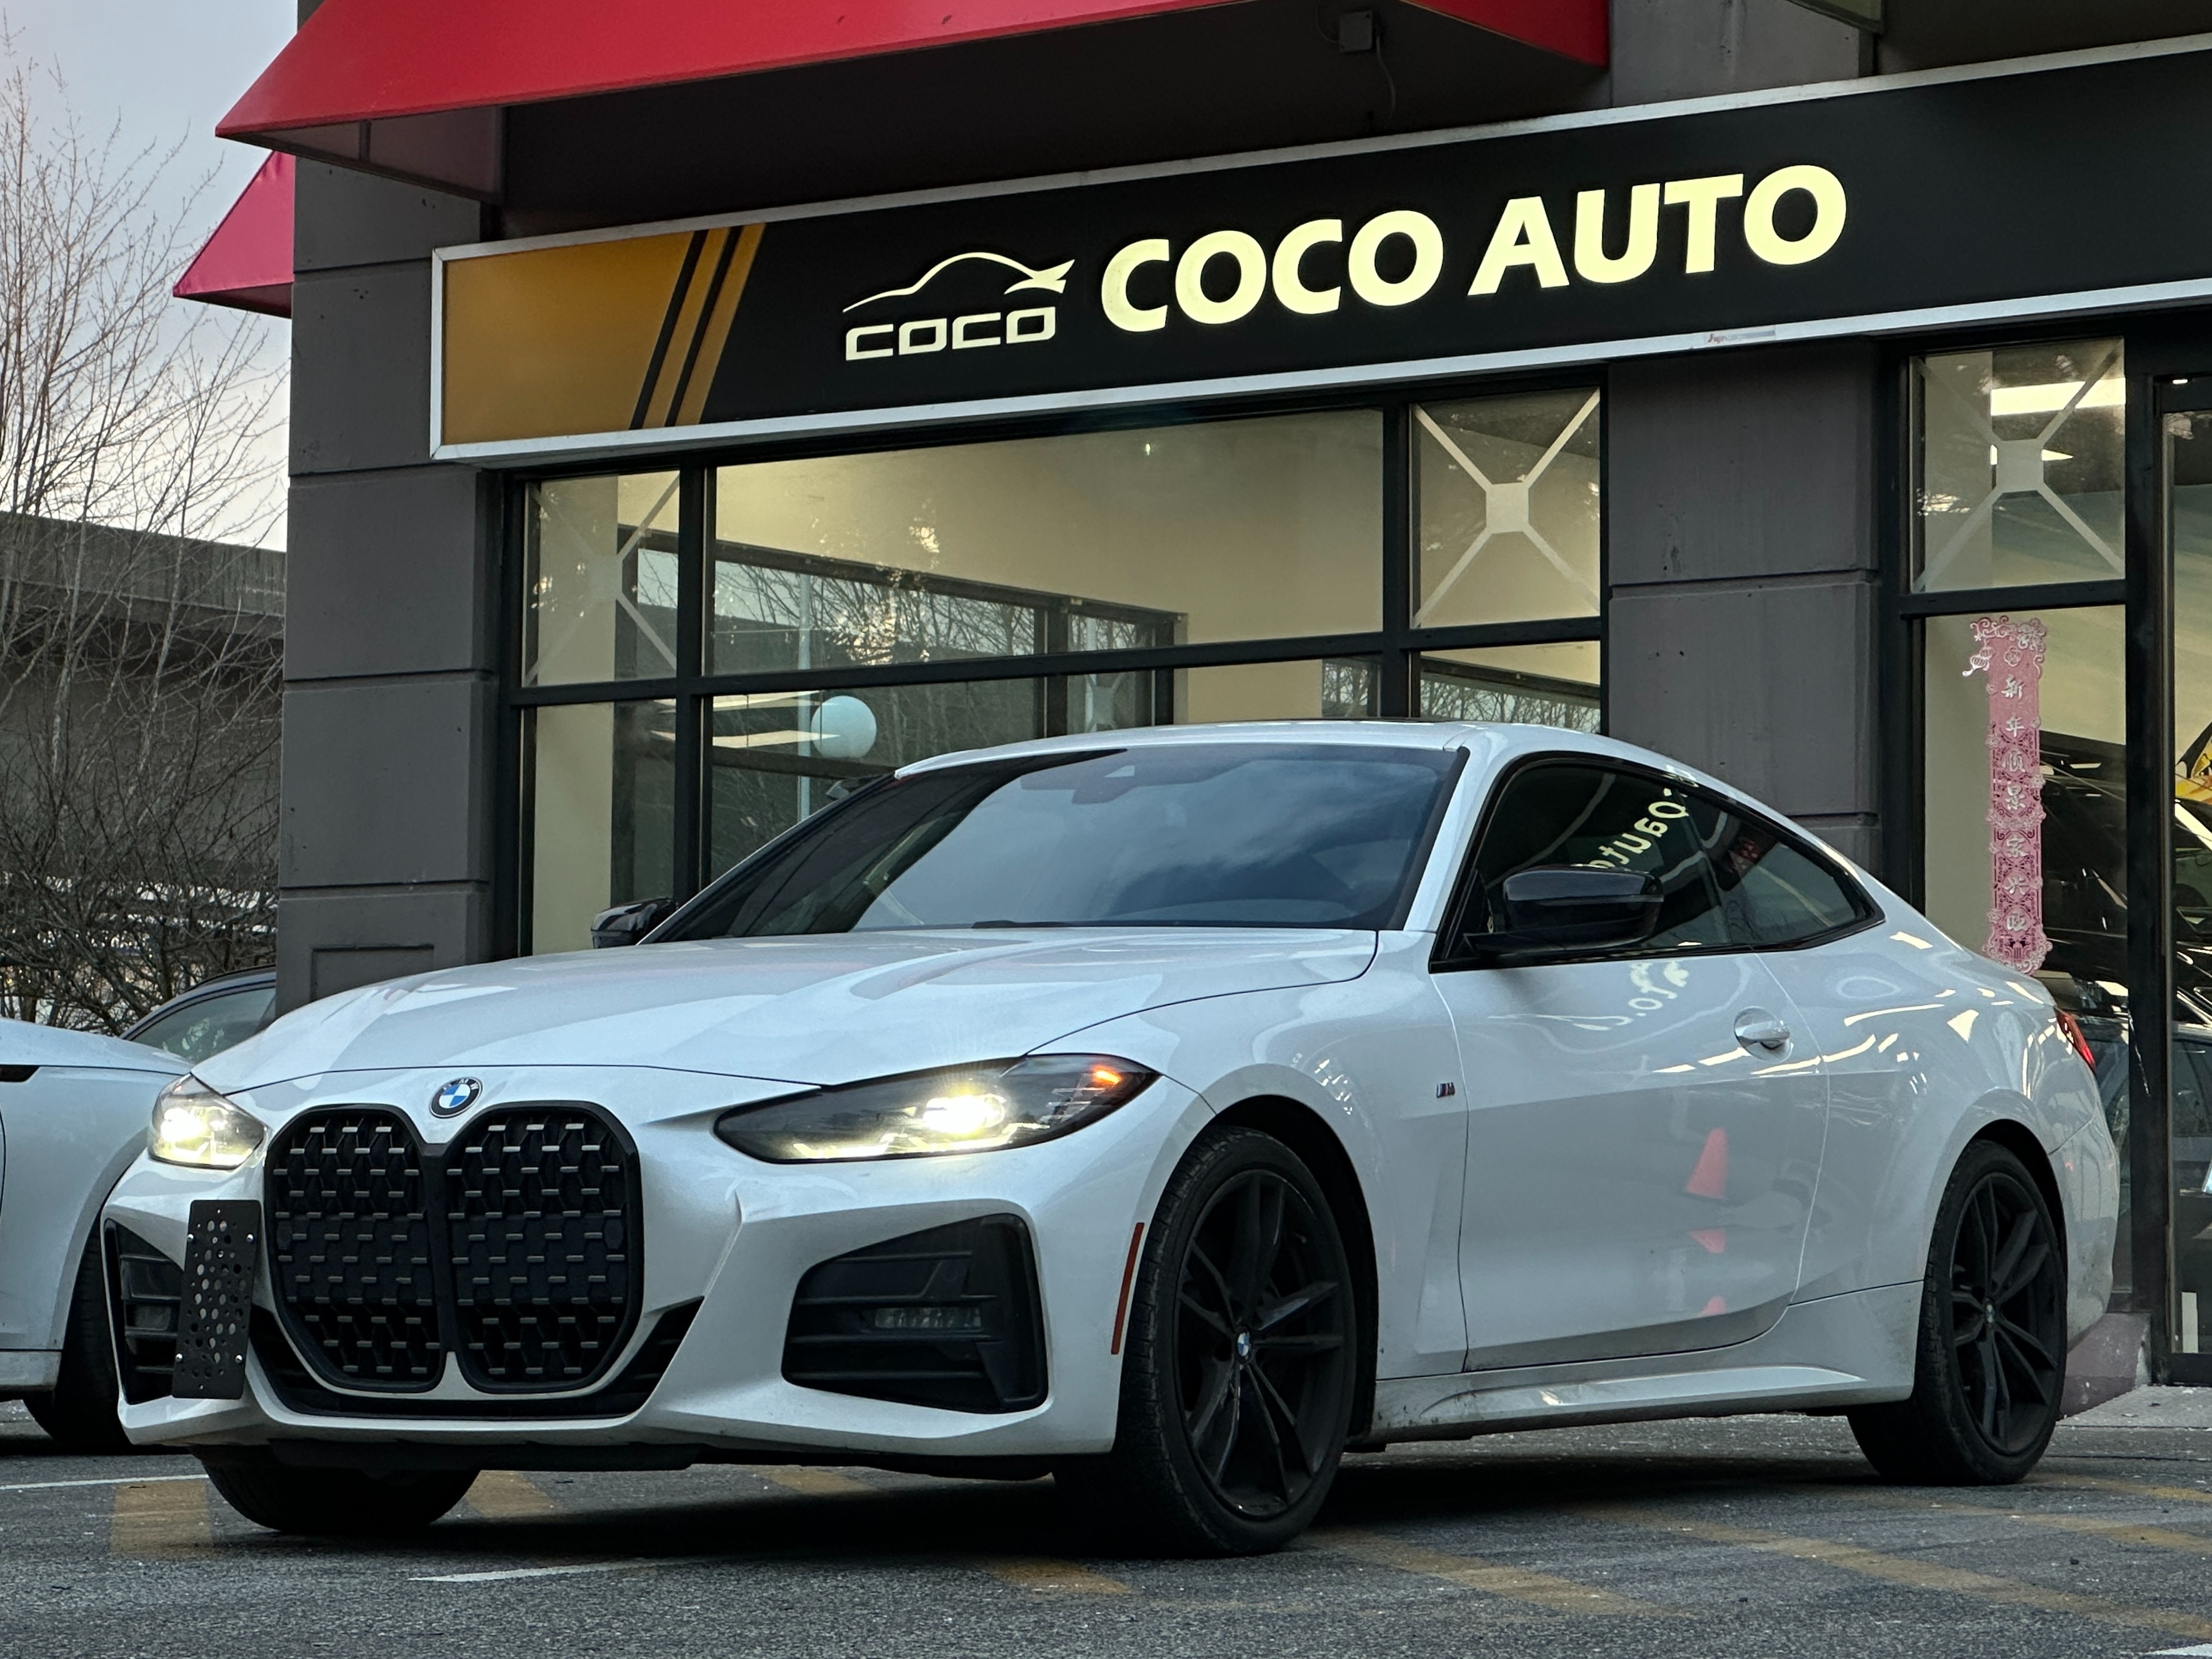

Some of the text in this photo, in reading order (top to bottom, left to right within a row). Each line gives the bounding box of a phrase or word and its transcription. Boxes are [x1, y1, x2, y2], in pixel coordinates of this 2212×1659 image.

[1101, 164, 1847, 332] COCO AUTO
[846, 306, 1056, 361] COCO
